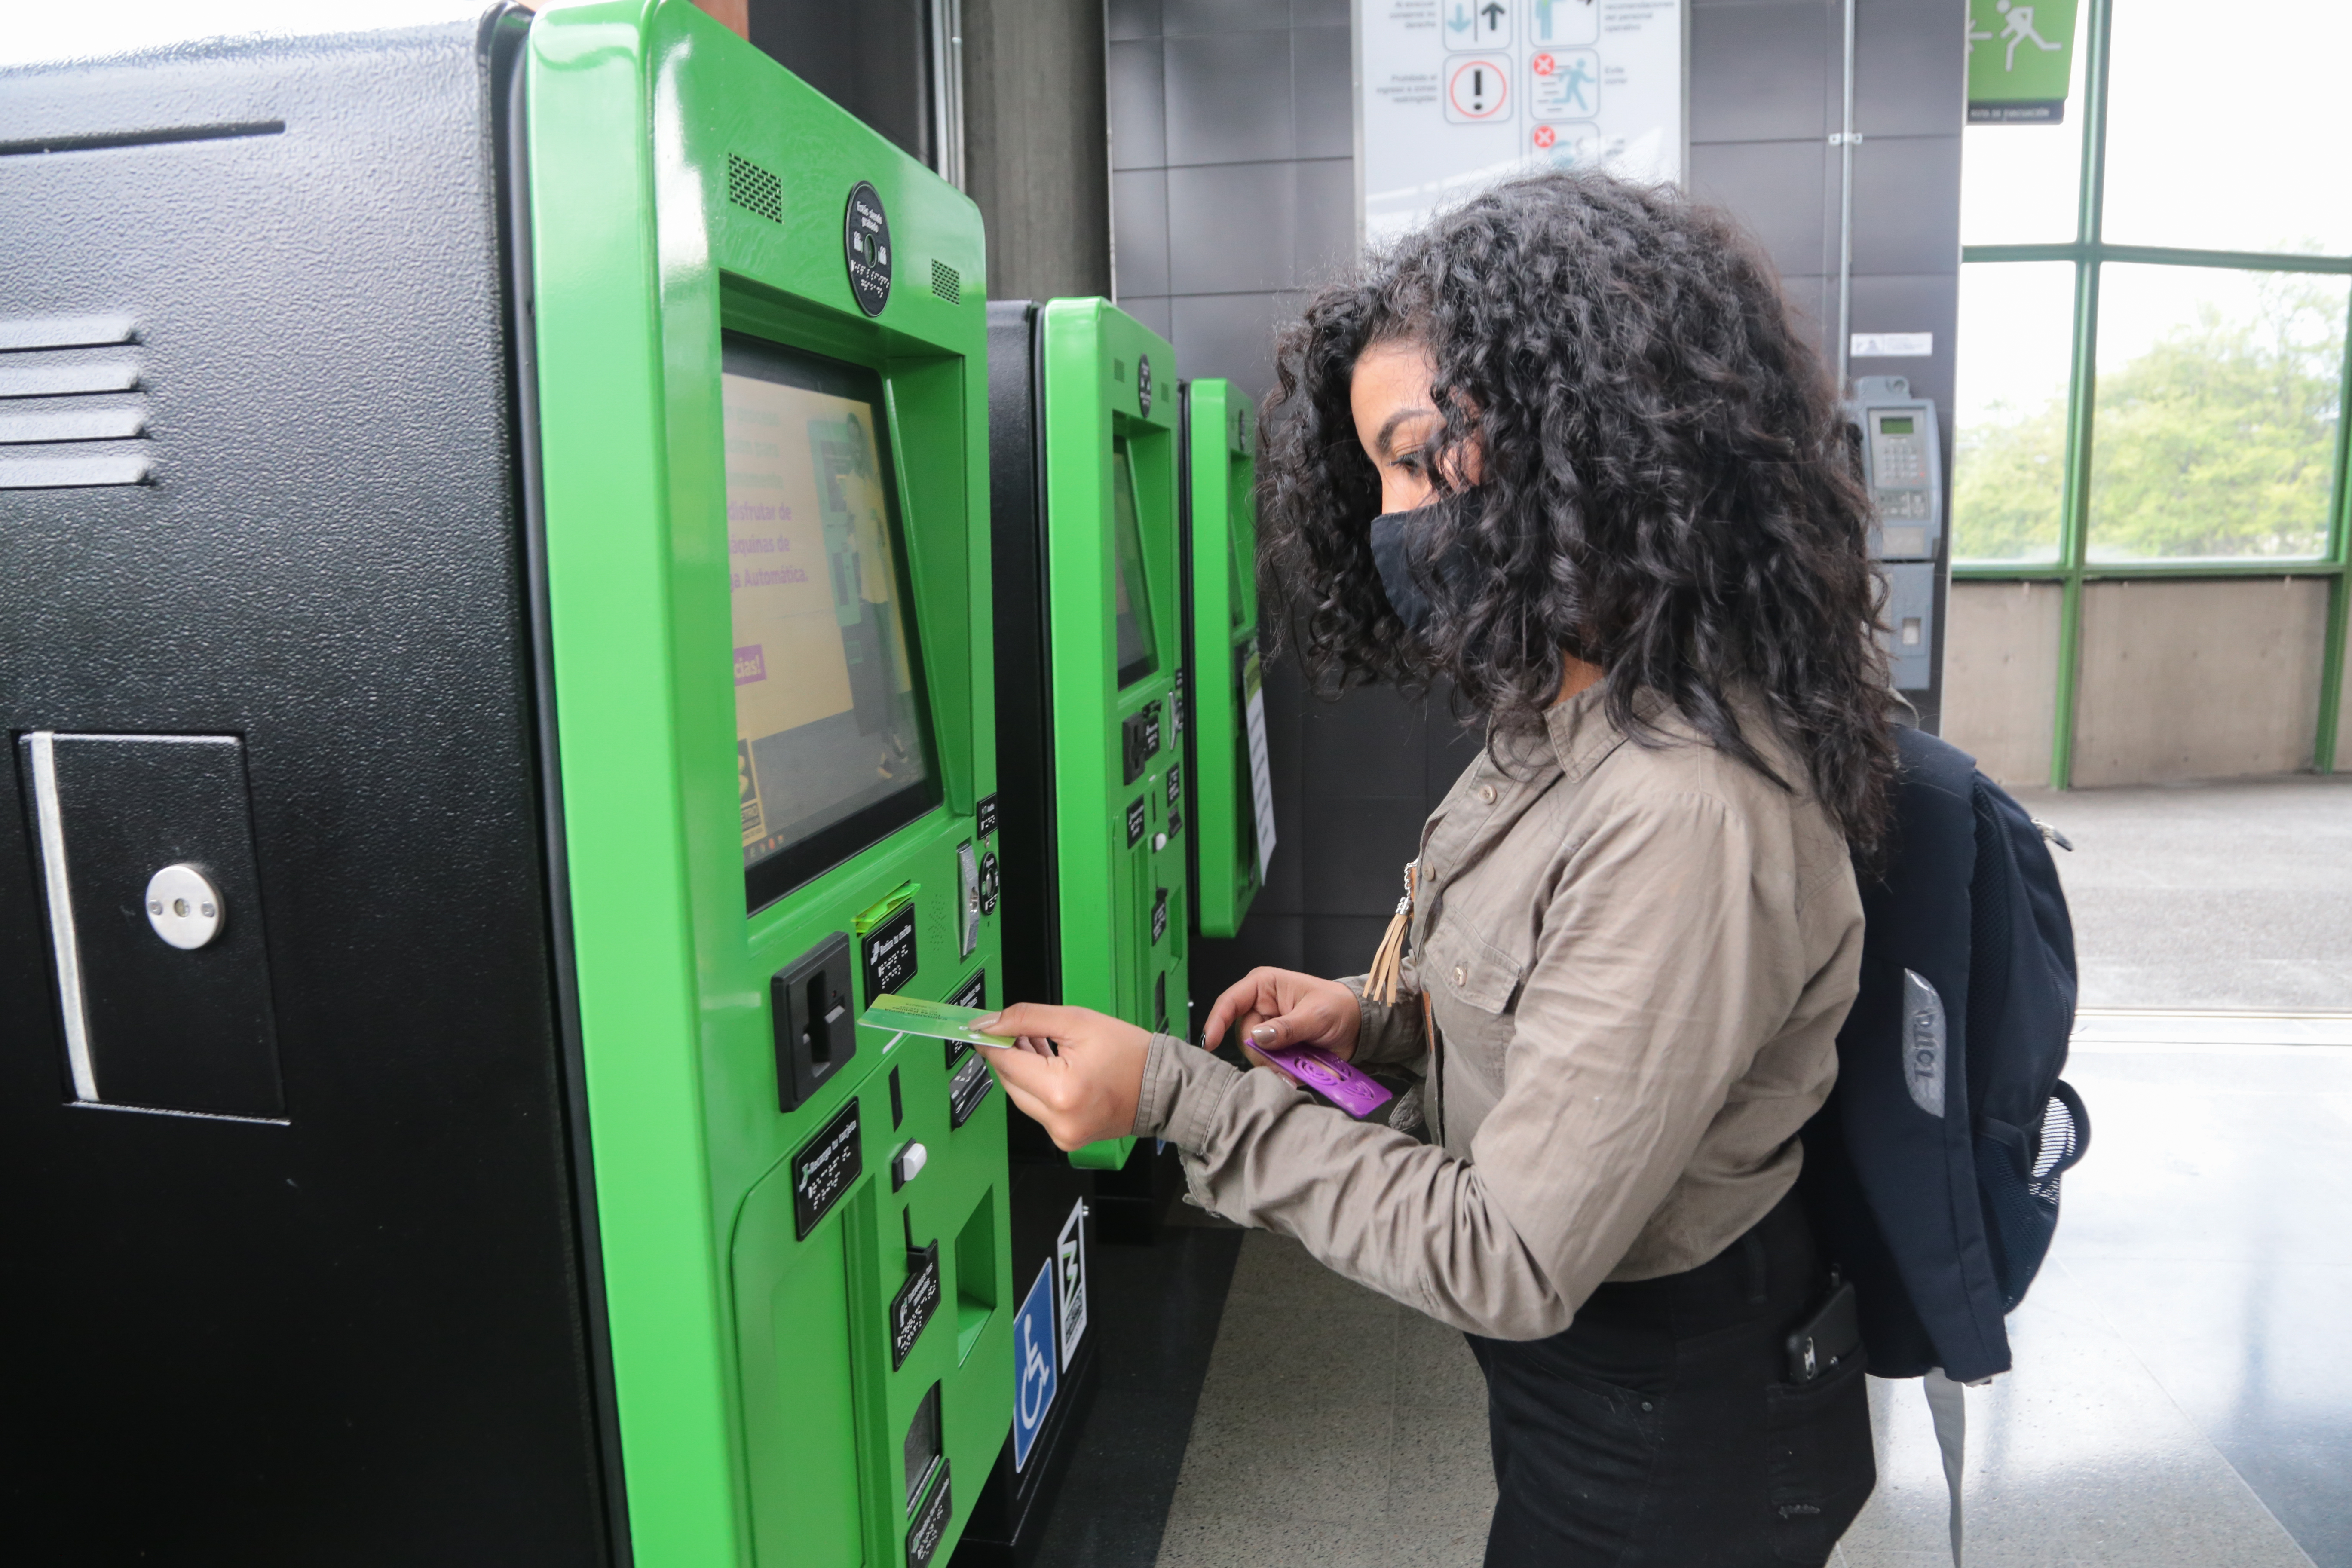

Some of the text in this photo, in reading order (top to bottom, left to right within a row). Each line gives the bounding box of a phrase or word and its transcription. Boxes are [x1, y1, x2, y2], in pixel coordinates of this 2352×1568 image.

[779, 502, 792, 521] de
[729, 533, 790, 557] áquinas de
